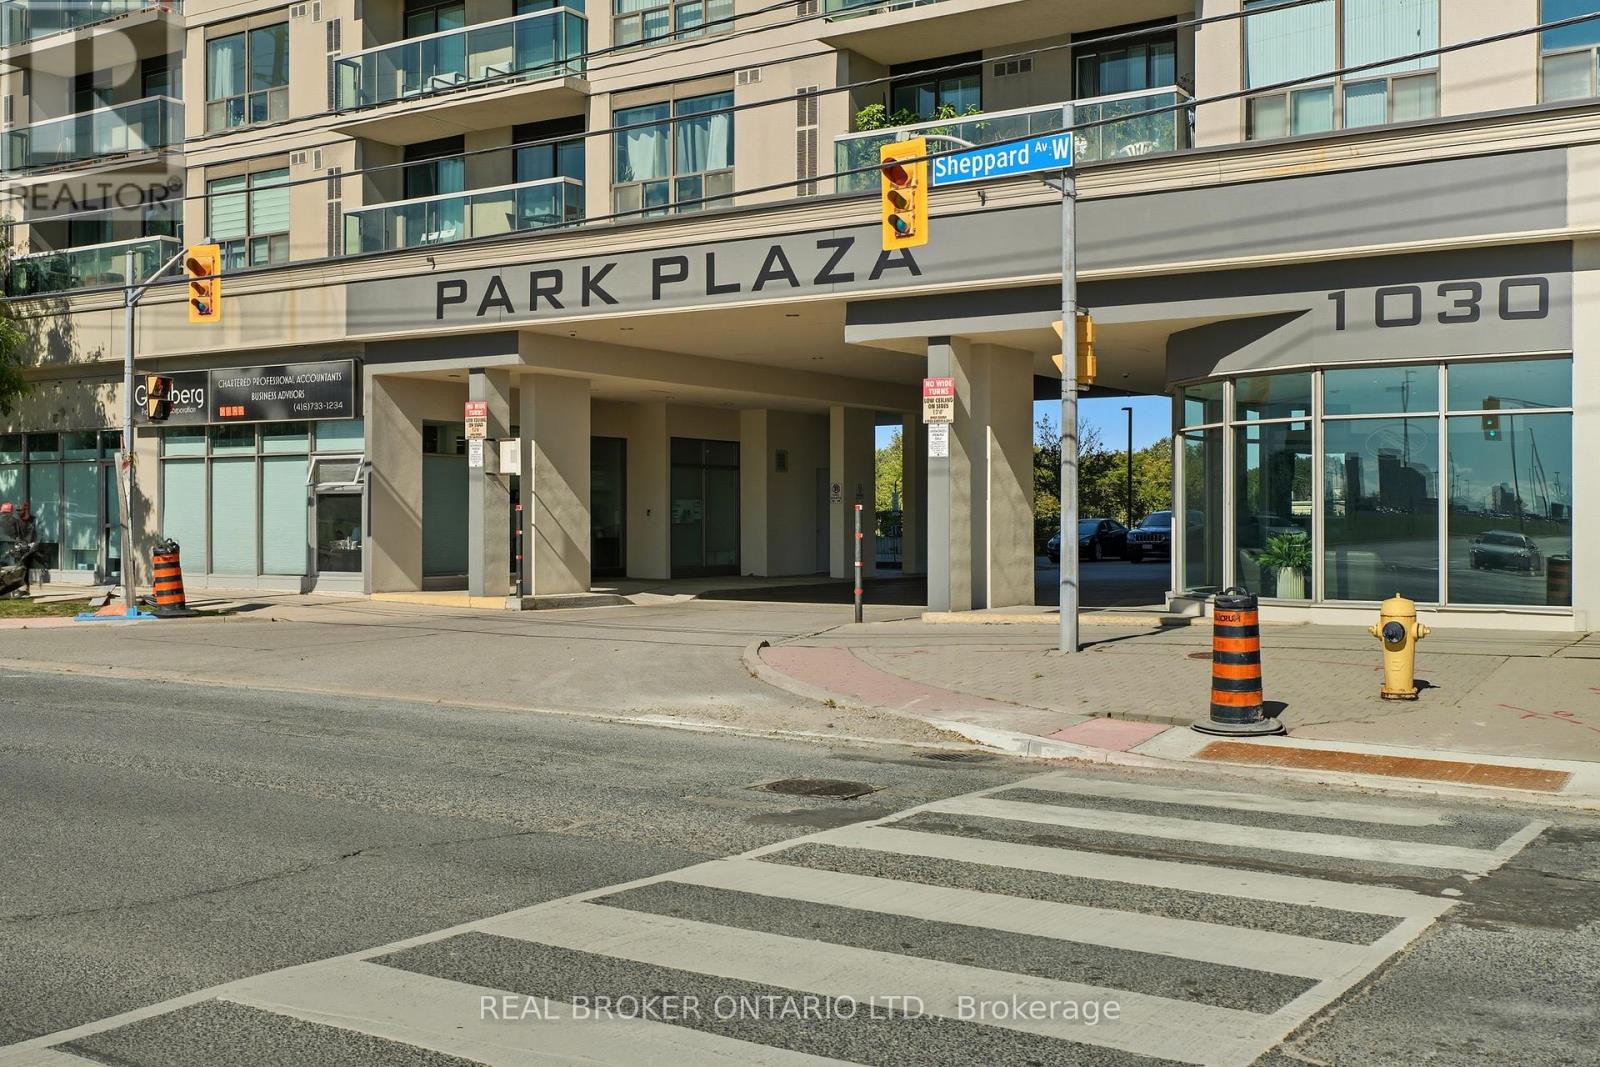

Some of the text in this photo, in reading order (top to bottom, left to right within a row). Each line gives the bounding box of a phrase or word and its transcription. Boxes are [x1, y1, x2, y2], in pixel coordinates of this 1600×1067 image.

[935, 137, 1070, 178] Sheppard Av W
[436, 236, 923, 320] PARK PLAZA
[1327, 276, 1550, 332] 1030
[218, 371, 342, 389] CHARTERED PROFESSIONAL ACCOUNTANTS
[936, 379, 953, 387] WIDE
[134, 384, 204, 409] Gberg
[251, 389, 305, 401] BUSINESS ADVISORS
[293, 401, 343, 412] (416)733-1234
